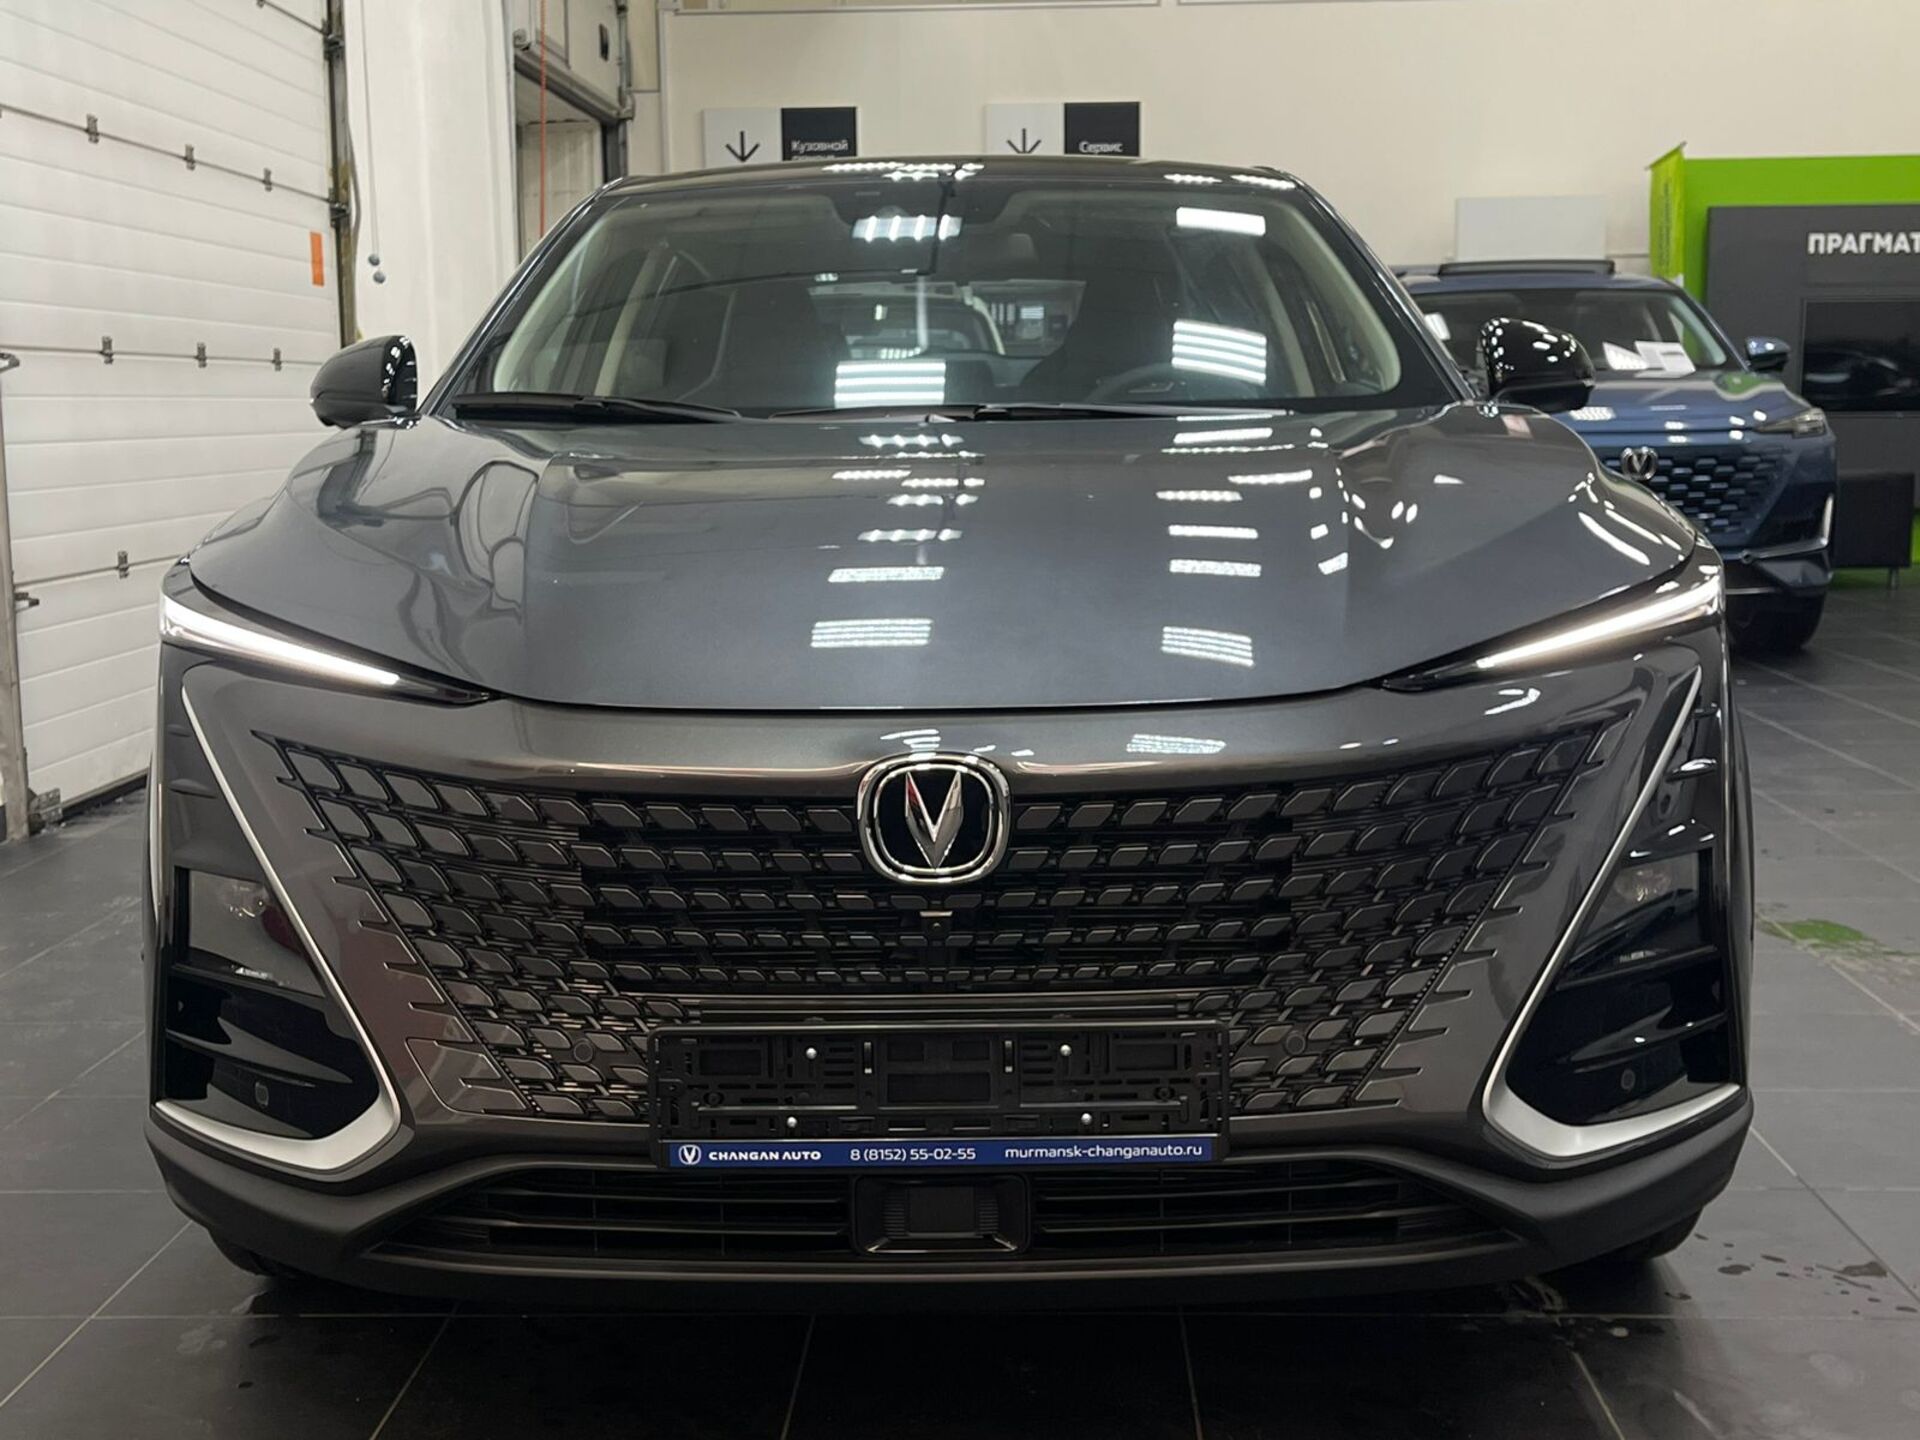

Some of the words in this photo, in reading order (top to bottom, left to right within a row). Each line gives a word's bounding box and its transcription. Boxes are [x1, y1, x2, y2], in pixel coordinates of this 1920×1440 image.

[791, 139, 849, 154] Кузовной
[1079, 141, 1123, 155] Сервис
[708, 1151, 780, 1160] CHANGAN
[782, 1151, 822, 1160] AUTO
[850, 1148, 861, 1161] 8
[864, 1148, 907, 1162] (8152)
[910, 1147, 977, 1160] 55-02-55
[1005, 1144, 1203, 1159] murmansk-changanauto.ru
